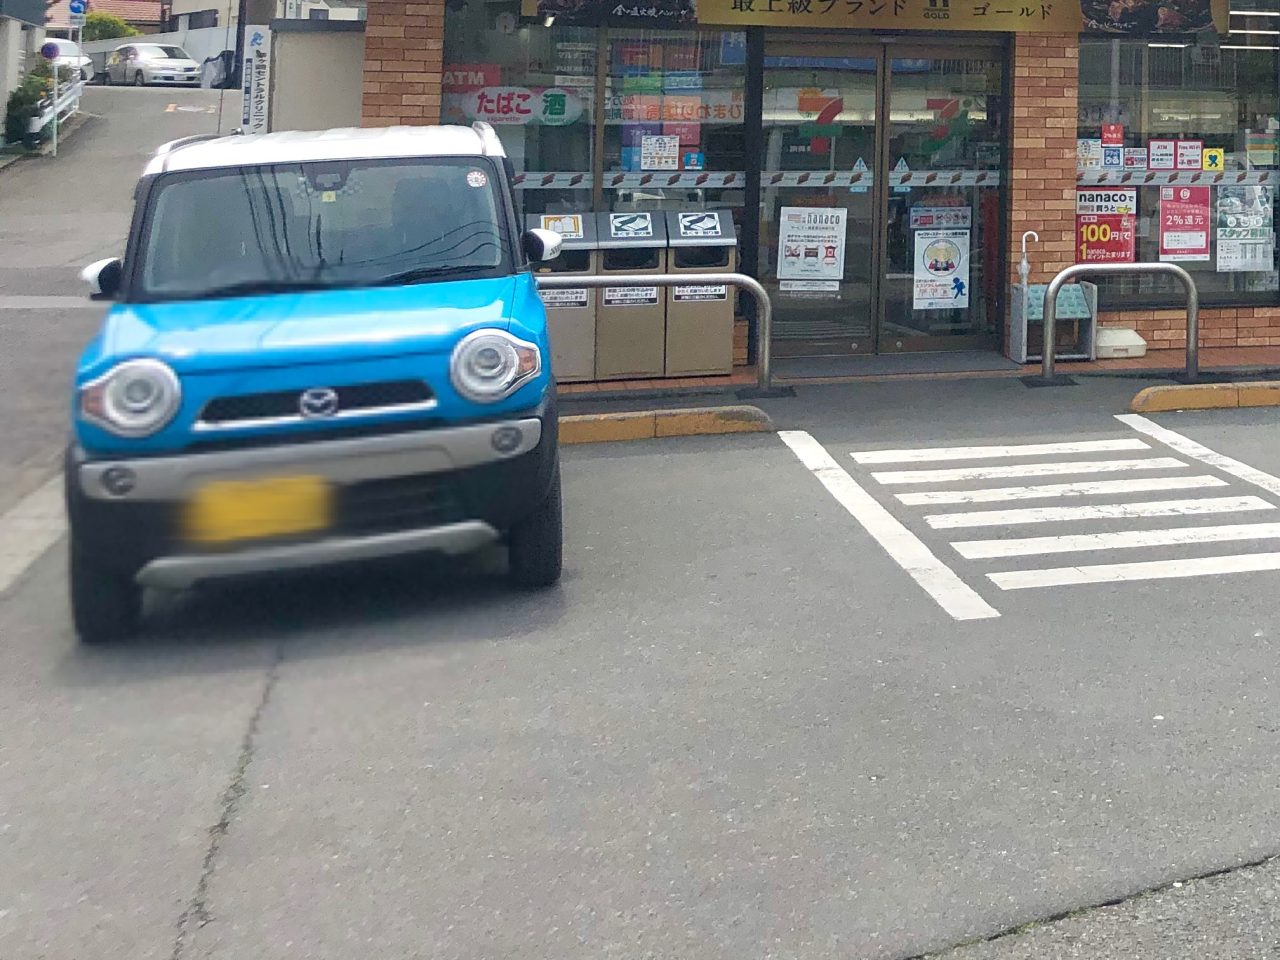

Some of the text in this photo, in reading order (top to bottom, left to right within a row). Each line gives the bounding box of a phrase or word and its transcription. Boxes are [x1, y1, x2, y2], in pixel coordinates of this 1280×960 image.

[973, 3, 1053, 20] ゴールド
[443, 71, 485, 85] ATM
[477, 91, 567, 116] たばこ 酒
[1079, 193, 1134, 203] nanacoで
[807, 214, 840, 225] nanaco
[1166, 215, 1204, 225] 2%還元
